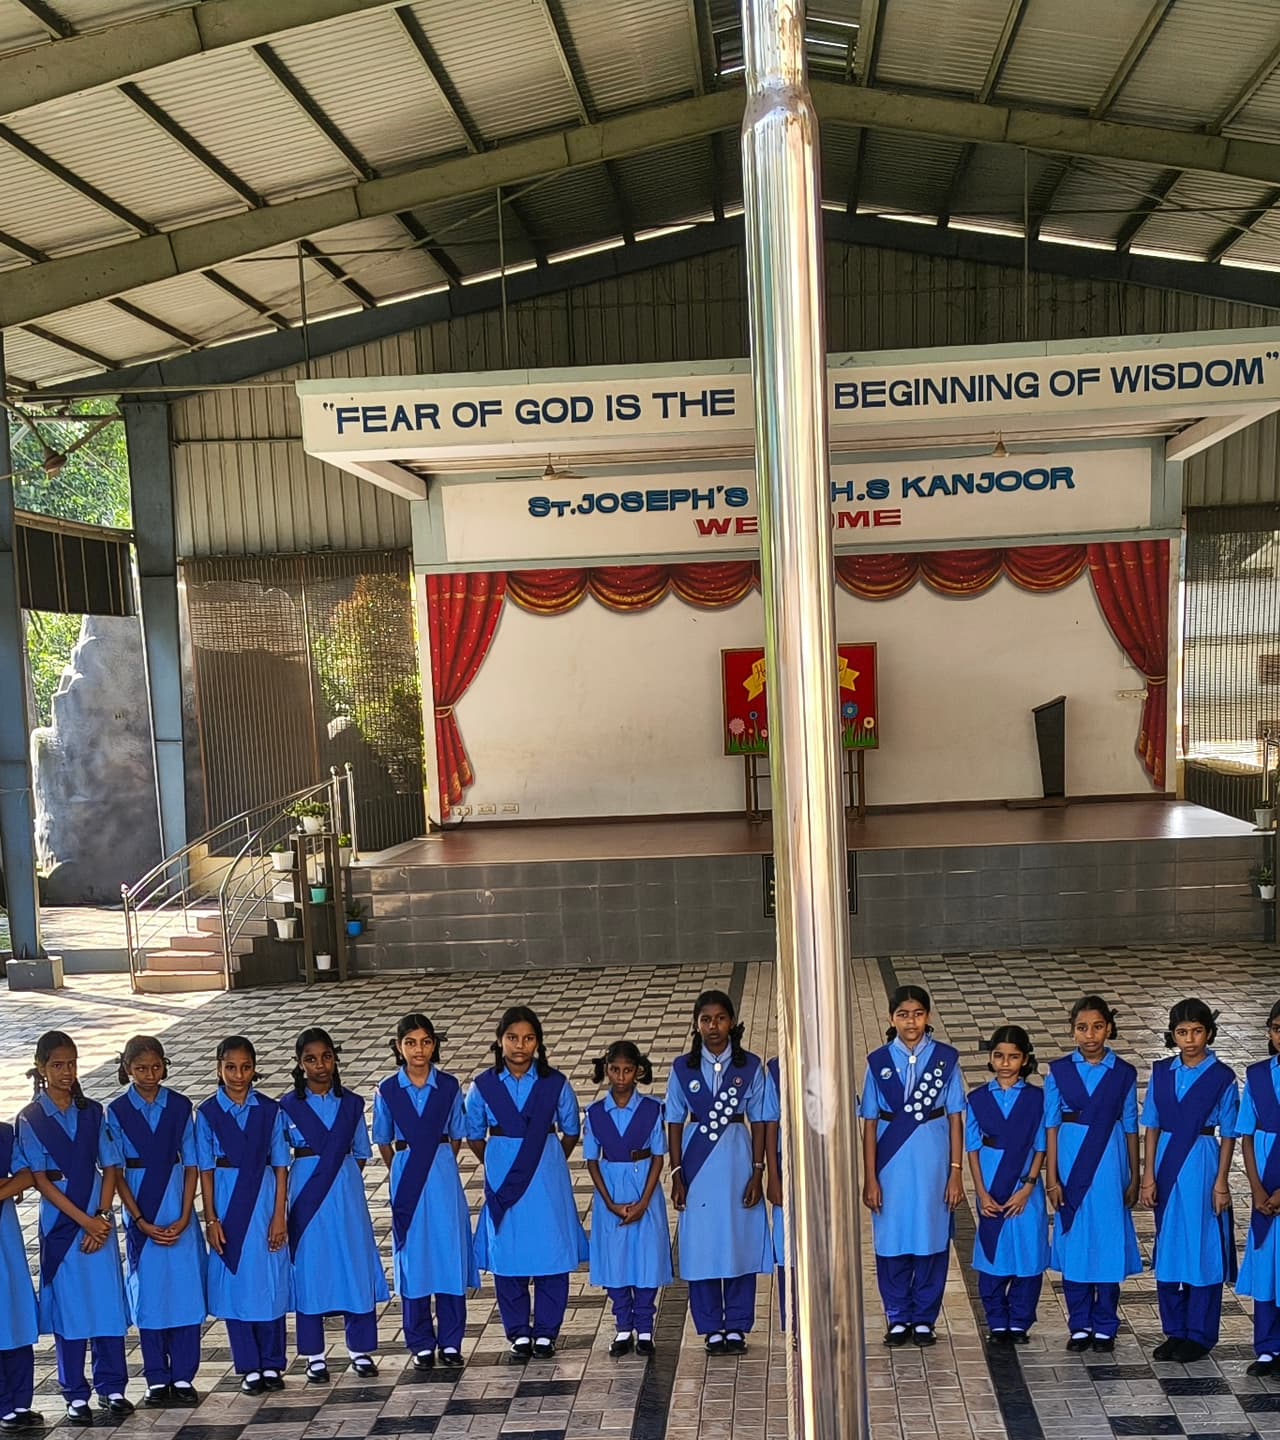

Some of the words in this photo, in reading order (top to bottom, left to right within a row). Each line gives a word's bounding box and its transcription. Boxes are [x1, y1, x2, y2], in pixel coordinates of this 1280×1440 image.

[322, 402, 441, 434] "FEAR
[452, 400, 503, 428] OF
[515, 396, 593, 425] GOD
[606, 393, 641, 422] IS
[652, 388, 735, 419] THE
[834, 371, 1039, 410] BEGINNING
[1049, 368, 1100, 398] OF
[1110, 351, 1279, 393] WISDOM"
[902, 466, 1075, 498] KANJOOR
